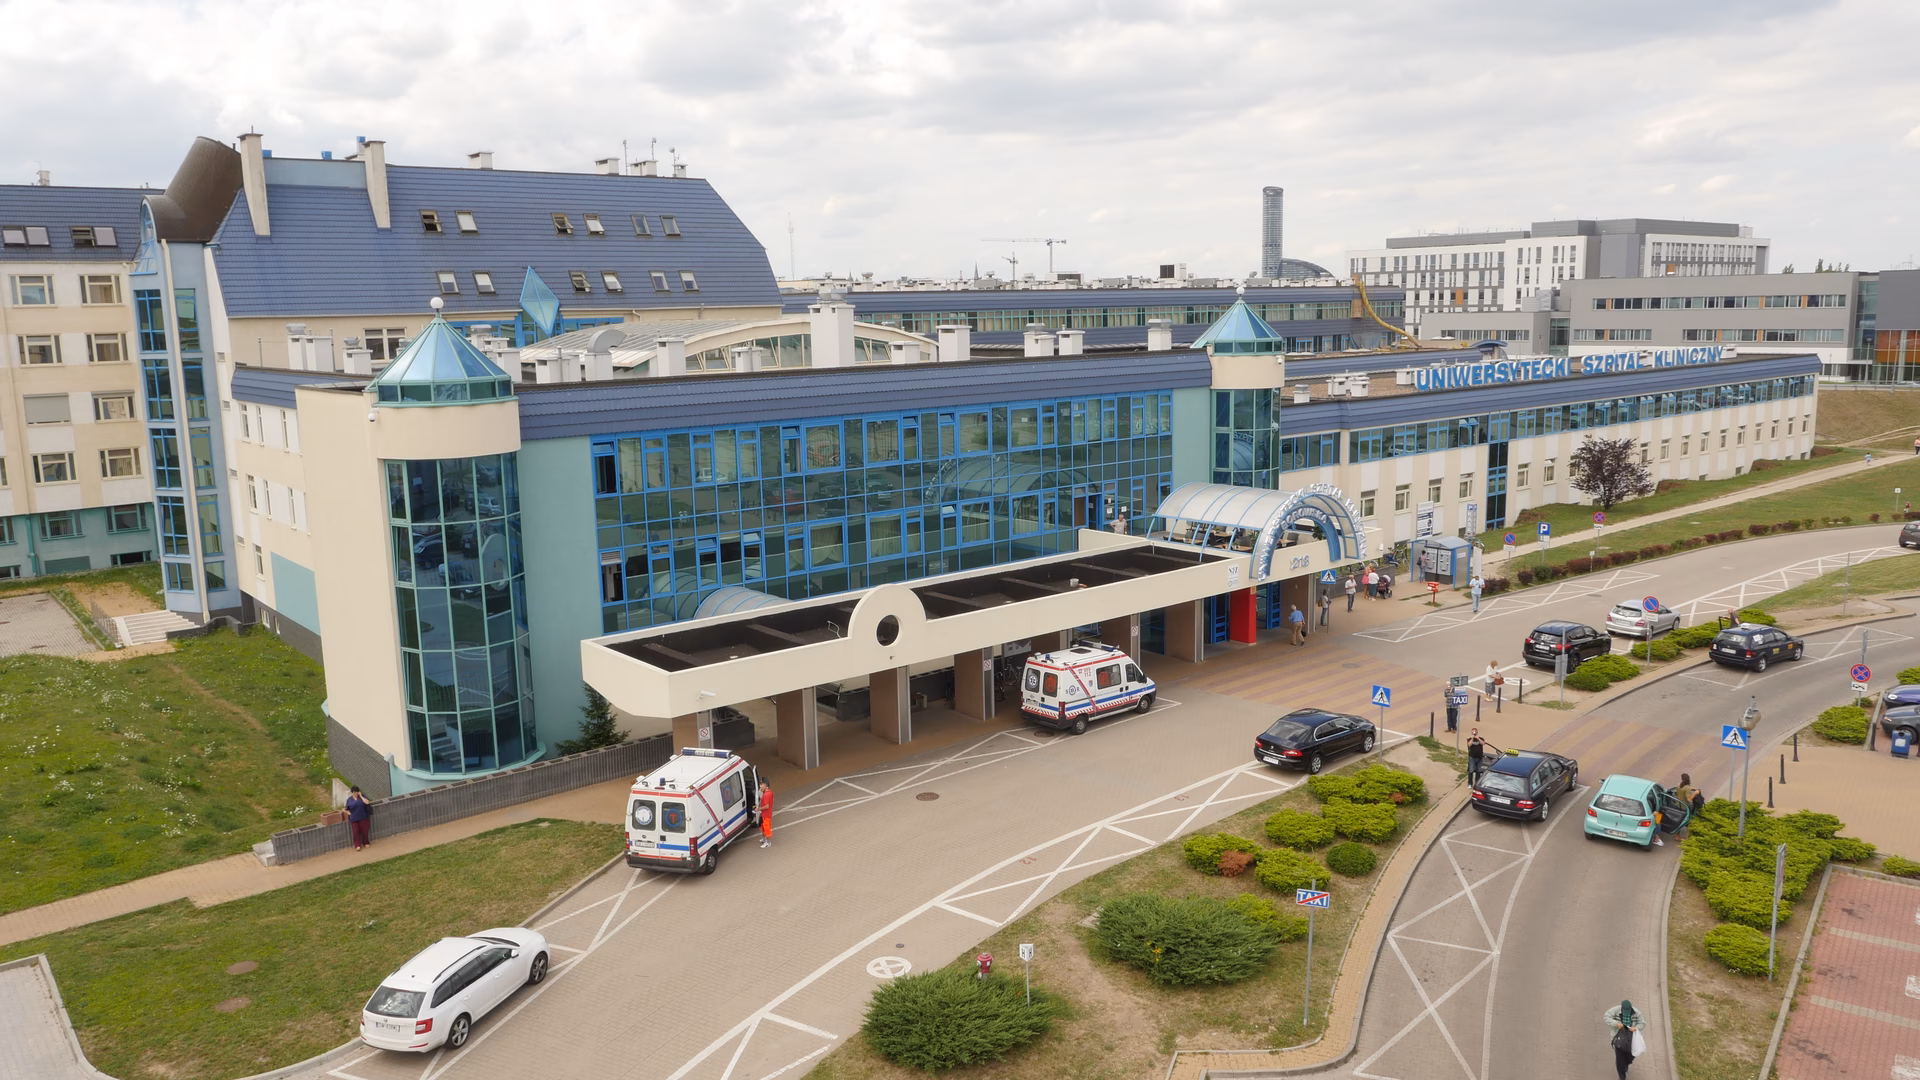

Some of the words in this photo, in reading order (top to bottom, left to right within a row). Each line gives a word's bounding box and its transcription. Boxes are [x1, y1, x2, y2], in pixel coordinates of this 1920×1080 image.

[1415, 358, 1572, 391] UNIWERSYTECKI
[1581, 351, 1645, 376] SZPITAL
[1651, 346, 1725, 369] KLINICZNY
[1540, 523, 1549, 533] P
[1452, 696, 1468, 704] TAXI
[1297, 891, 1328, 906] TAXI
